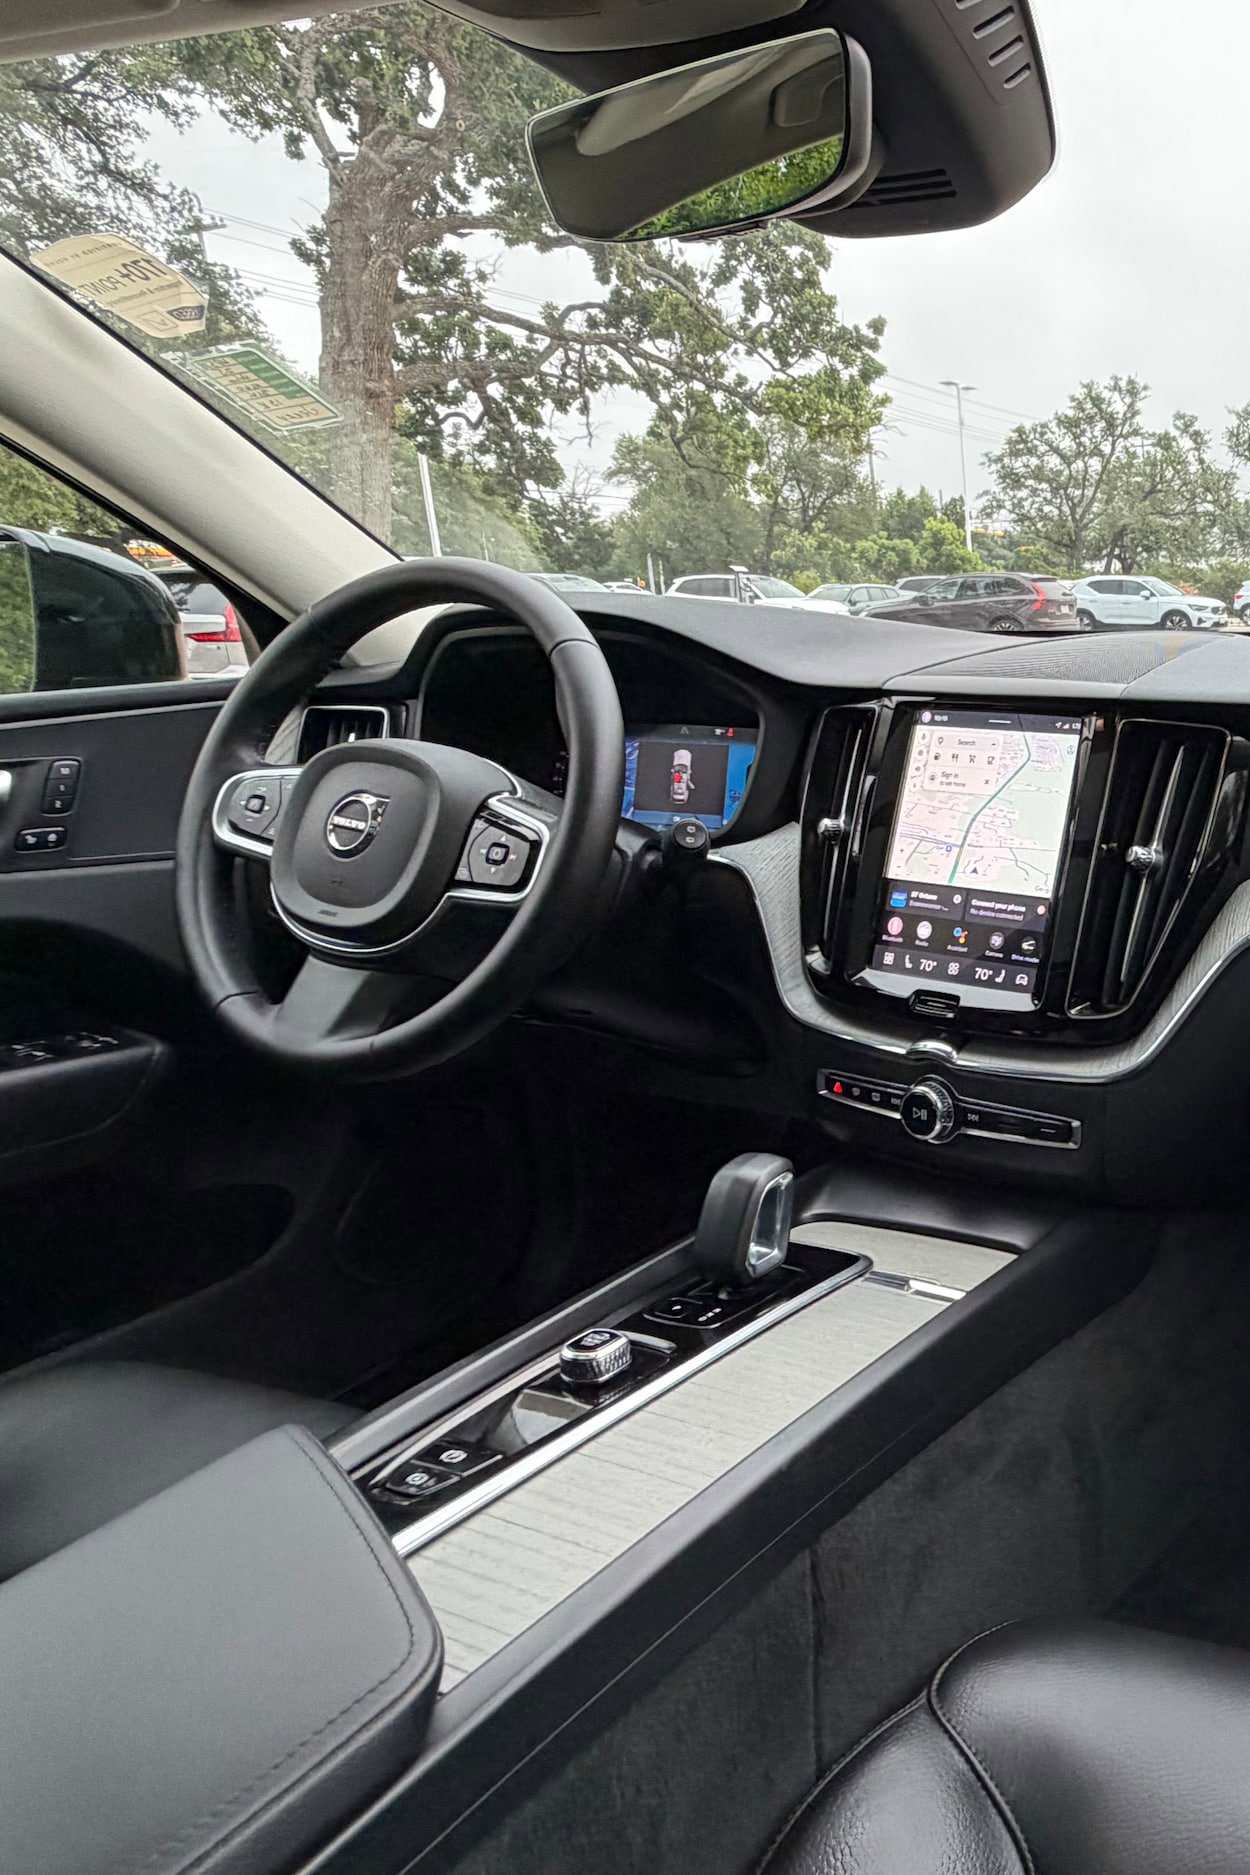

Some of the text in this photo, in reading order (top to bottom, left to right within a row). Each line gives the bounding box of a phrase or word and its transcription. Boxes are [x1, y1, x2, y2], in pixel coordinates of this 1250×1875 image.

[941, 771, 952, 780] Sign
[333, 815, 366, 830] VOLVO
[995, 902, 1007, 911] your
[1007, 903, 1026, 912] phone
[920, 959, 937, 972] 70°
[975, 968, 993, 980] 70°
